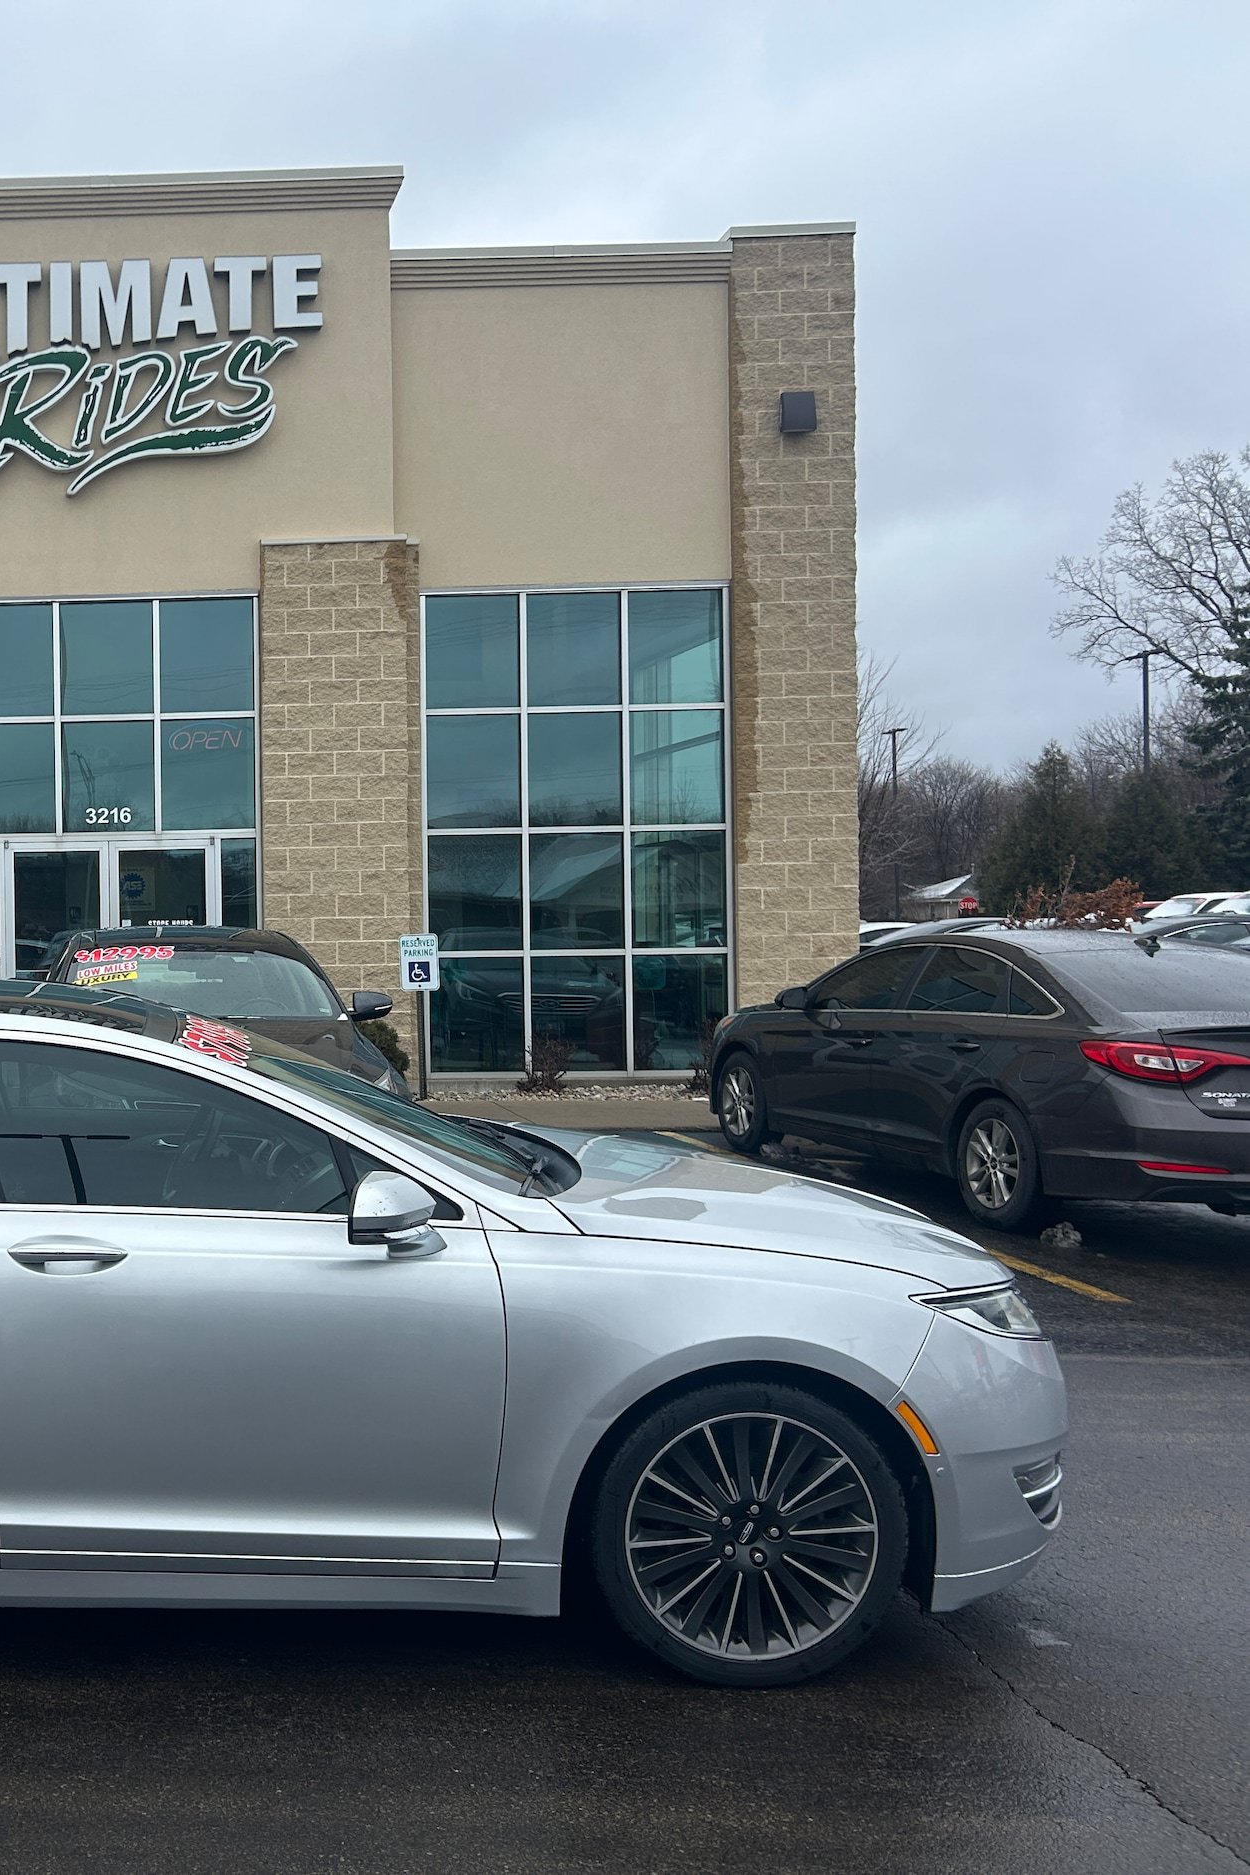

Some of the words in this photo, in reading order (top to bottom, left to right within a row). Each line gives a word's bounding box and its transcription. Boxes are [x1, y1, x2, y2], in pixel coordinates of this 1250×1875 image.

[173, 730, 243, 751] OPEN
[85, 807, 132, 824] 3216
[122, 880, 143, 891] ASE
[74, 946, 175, 963] $12995
[74, 972, 130, 985] UXURY
[78, 967, 103, 979] LOW
[104, 961, 137, 973] MILES
